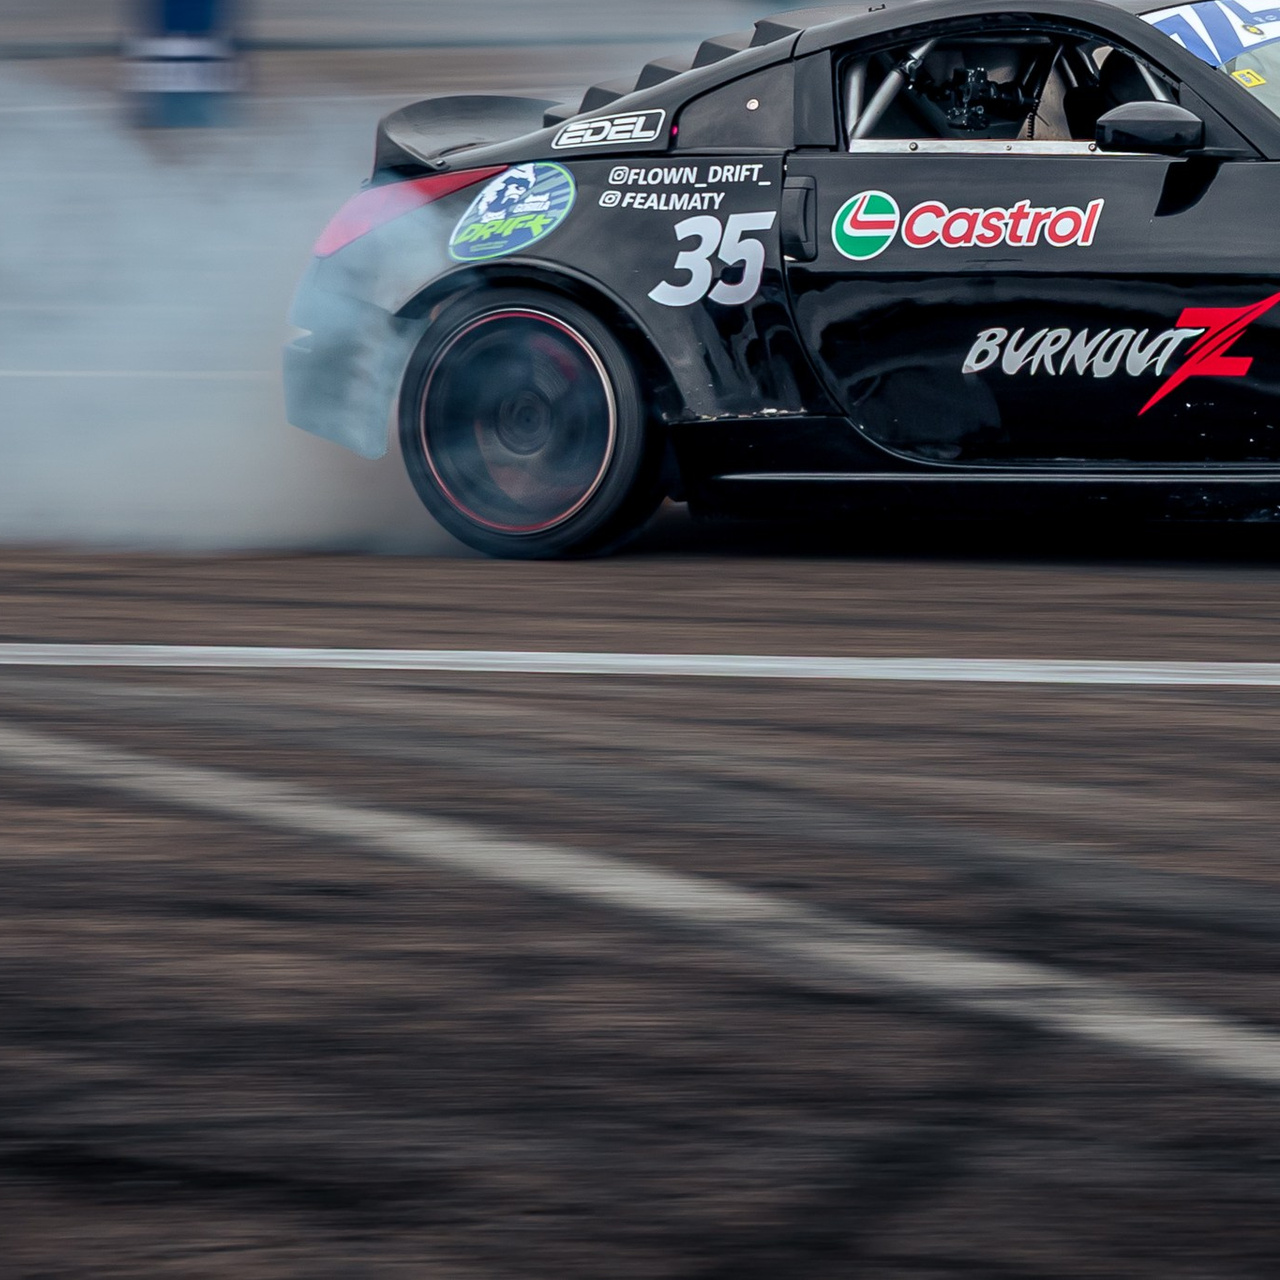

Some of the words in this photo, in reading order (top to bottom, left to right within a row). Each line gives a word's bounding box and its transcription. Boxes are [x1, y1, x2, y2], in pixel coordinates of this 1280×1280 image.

[557, 116, 656, 146] EDEL
[628, 163, 772, 188] FLOWN_DRIFT_
[621, 191, 726, 211] FEALMATY
[453, 213, 554, 246] DRIFT
[901, 197, 1105, 249] Castrol
[648, 210, 777, 307] 35
[962, 326, 1206, 378] BURNOUT
